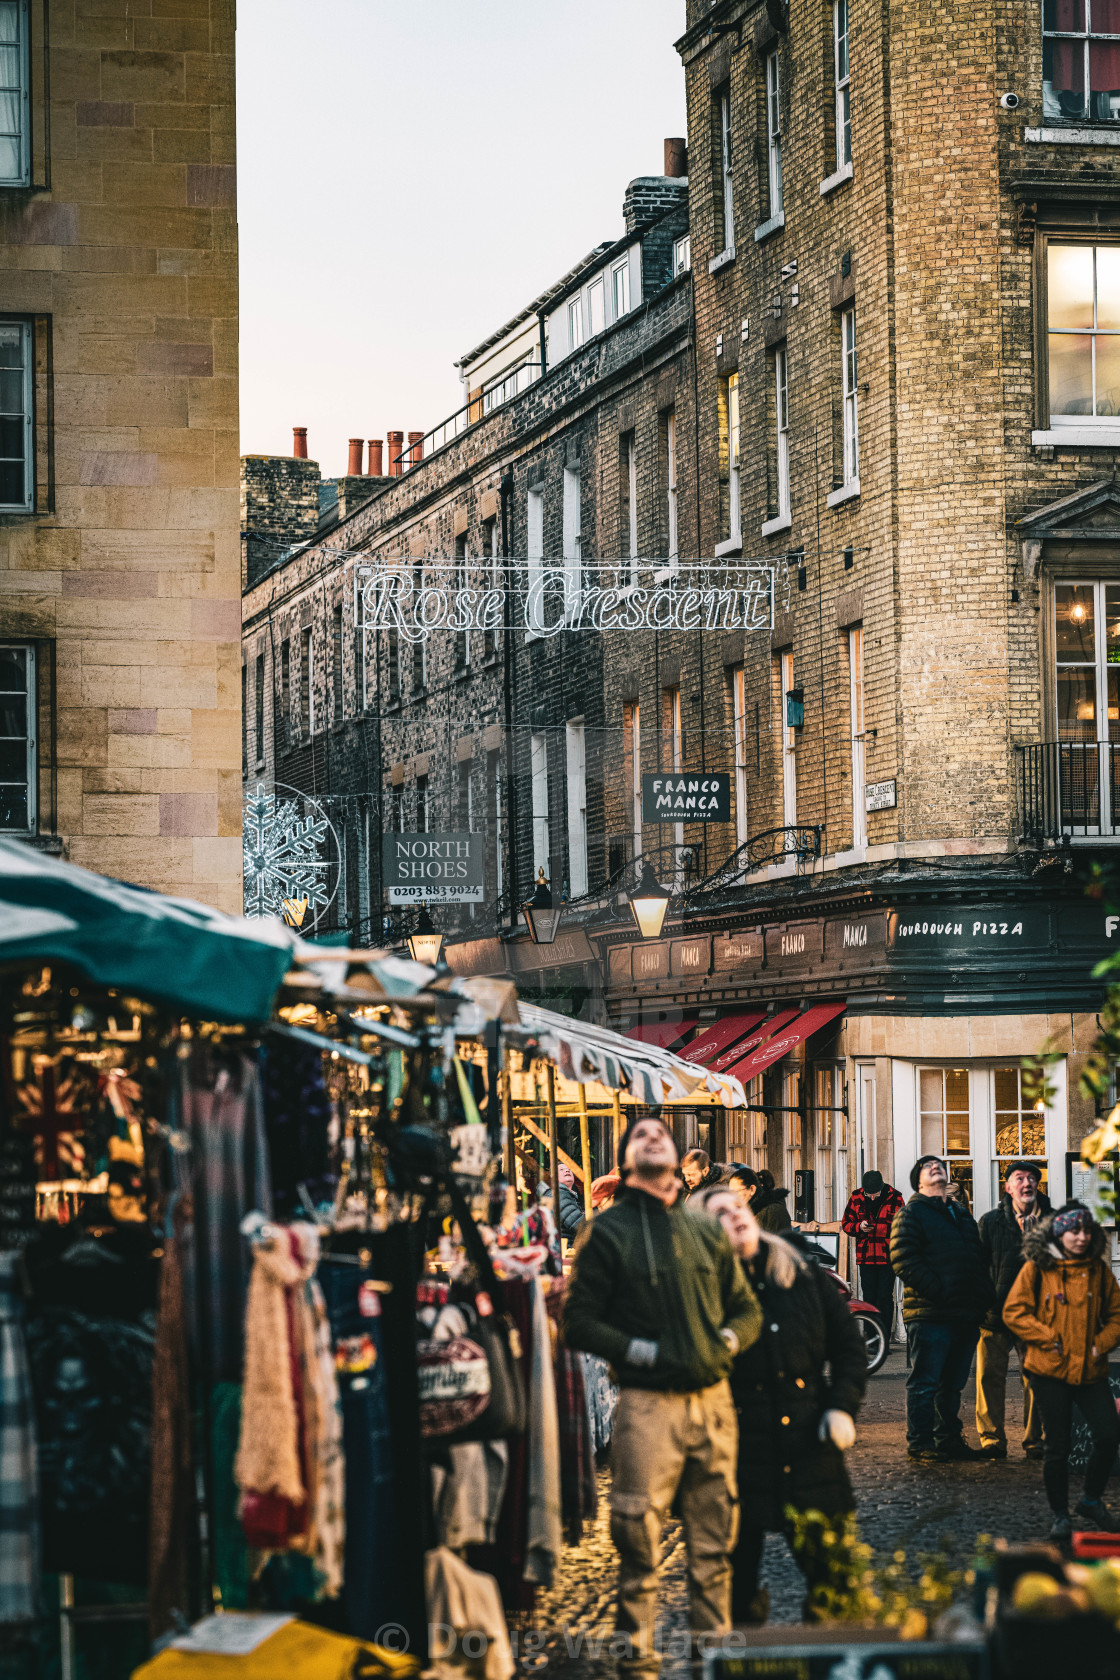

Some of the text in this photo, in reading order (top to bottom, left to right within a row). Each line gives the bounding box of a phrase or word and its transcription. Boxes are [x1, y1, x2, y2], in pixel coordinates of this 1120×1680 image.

[362, 570, 769, 643] Rose Crescent
[652, 780, 720, 793] FRANCO
[655, 794, 719, 810] MANCA
[395, 841, 472, 858] NORTH
[398, 861, 468, 878] SHOES
[394, 885, 480, 897] 0203 883 9024
[899, 921, 1023, 937] SOURDOUGH PIZZA
[680, 946, 700, 968] MANCA
[781, 933, 805, 957] FRANCO
[842, 924, 868, 949] MANCA
